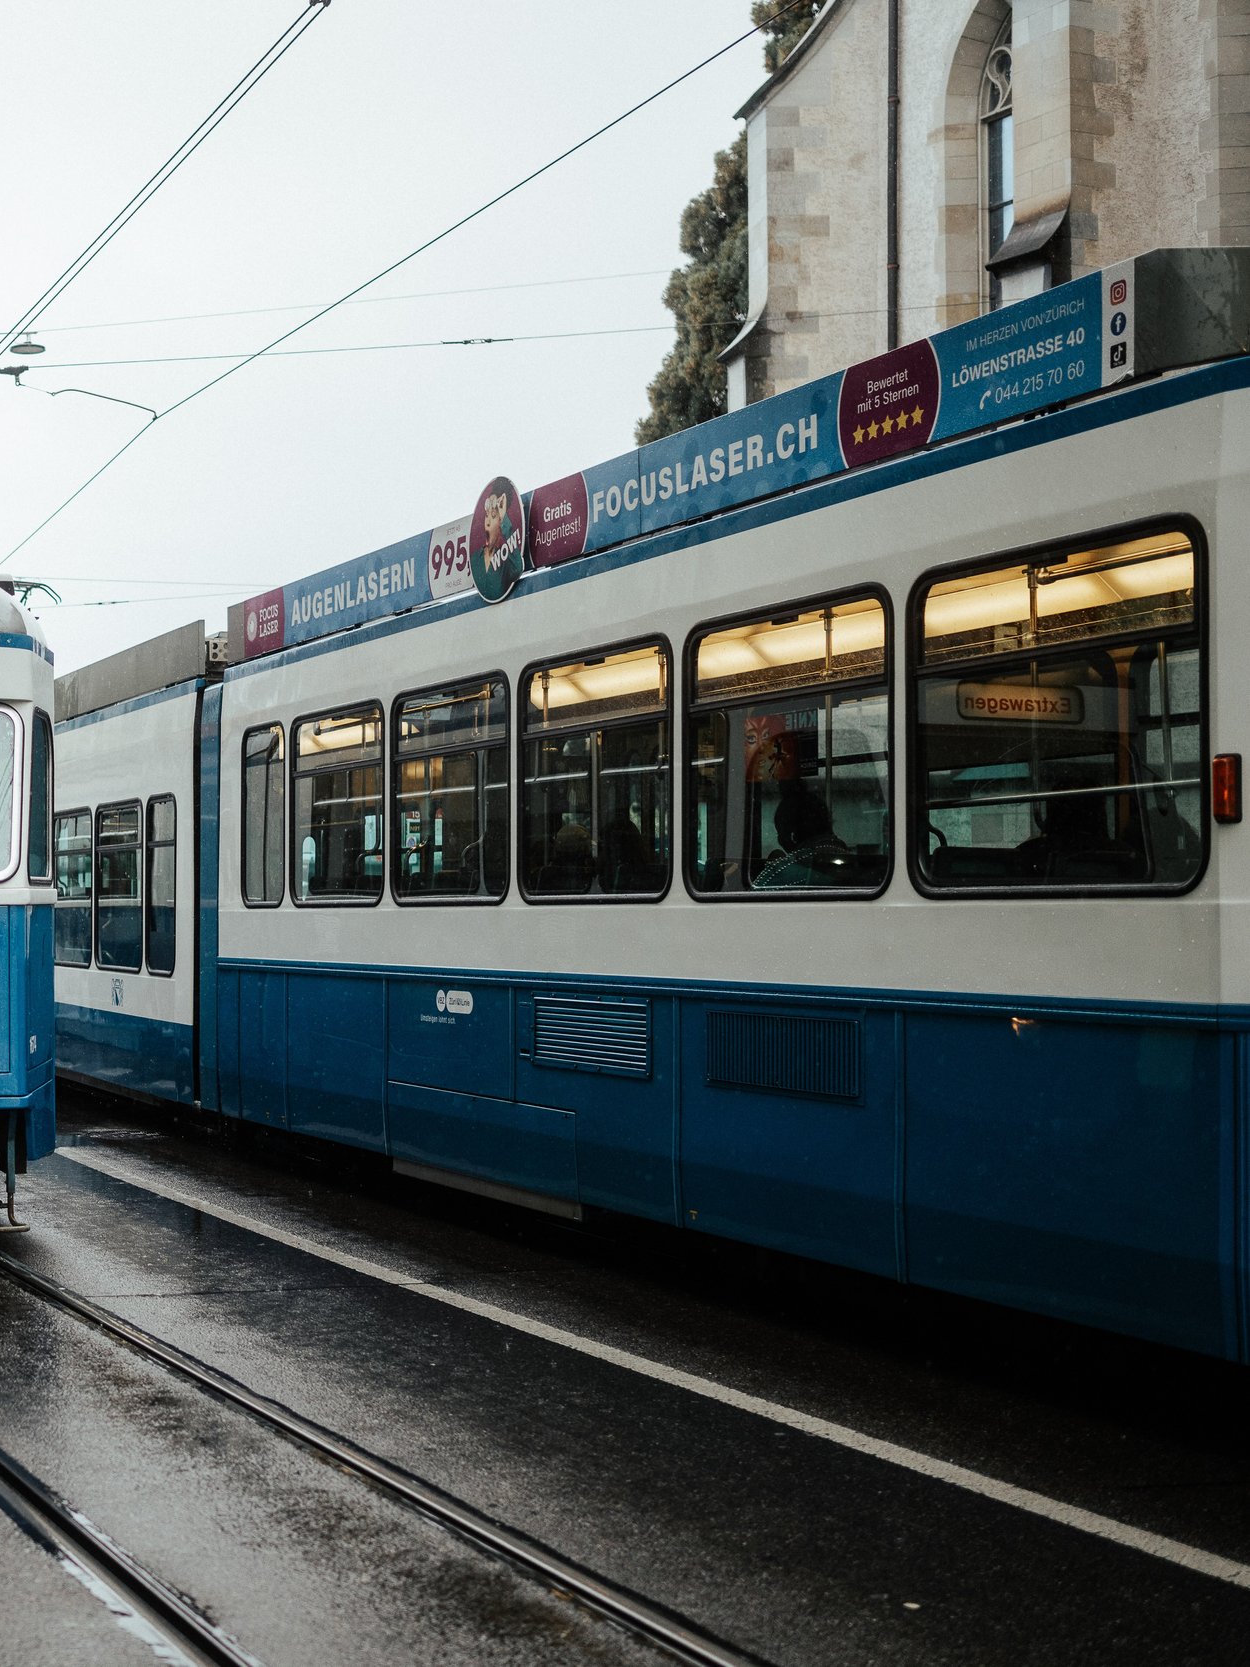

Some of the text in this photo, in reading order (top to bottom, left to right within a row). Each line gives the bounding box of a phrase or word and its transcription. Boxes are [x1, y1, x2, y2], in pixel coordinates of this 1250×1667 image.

[966, 298, 1085, 352] IM HERZEN VON ZÜRICH
[952, 327, 1085, 388] LÖWENSTRASSE 40
[857, 384, 919, 414] mit 5 Sternen
[867, 368, 909, 394] Bewertet
[995, 360, 1085, 404] 044 215 70 60
[592, 413, 818, 523] FOCUSLASER.CH
[543, 501, 572, 523] Gratis
[535, 516, 581, 547] Augentest!
[490, 529, 522, 571] WOW!
[291, 557, 415, 627] AUGENLASERN
[259, 604, 279, 622] FOCUS
[259, 621, 279, 637] LASER
